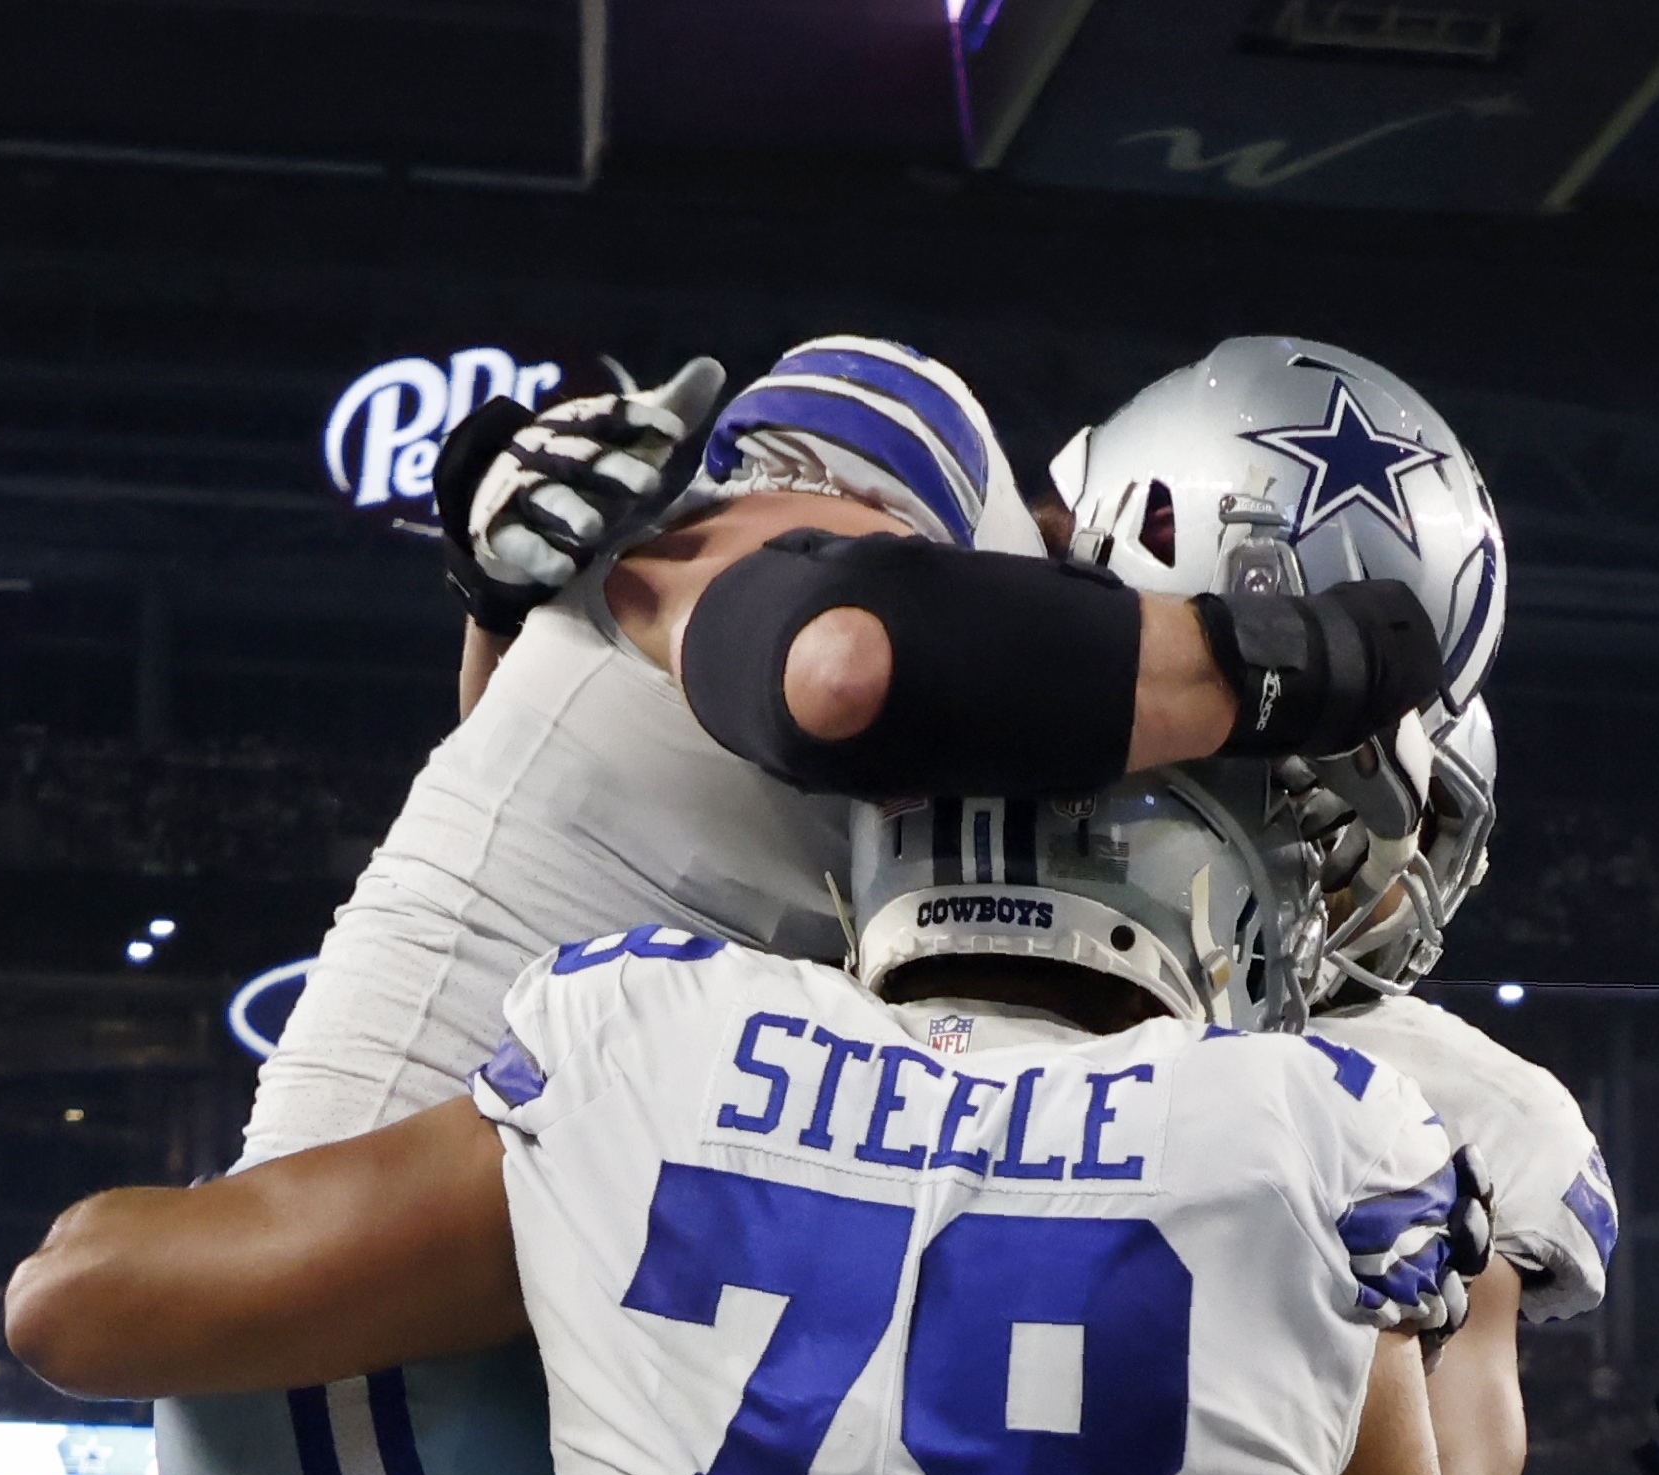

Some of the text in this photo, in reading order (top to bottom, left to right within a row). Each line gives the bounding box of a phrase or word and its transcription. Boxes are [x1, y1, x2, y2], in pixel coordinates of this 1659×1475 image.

[916, 896, 1053, 929] COWBOYS
[931, 1033, 966, 1053] NFL
[717, 1011, 1154, 1181] STEELE
